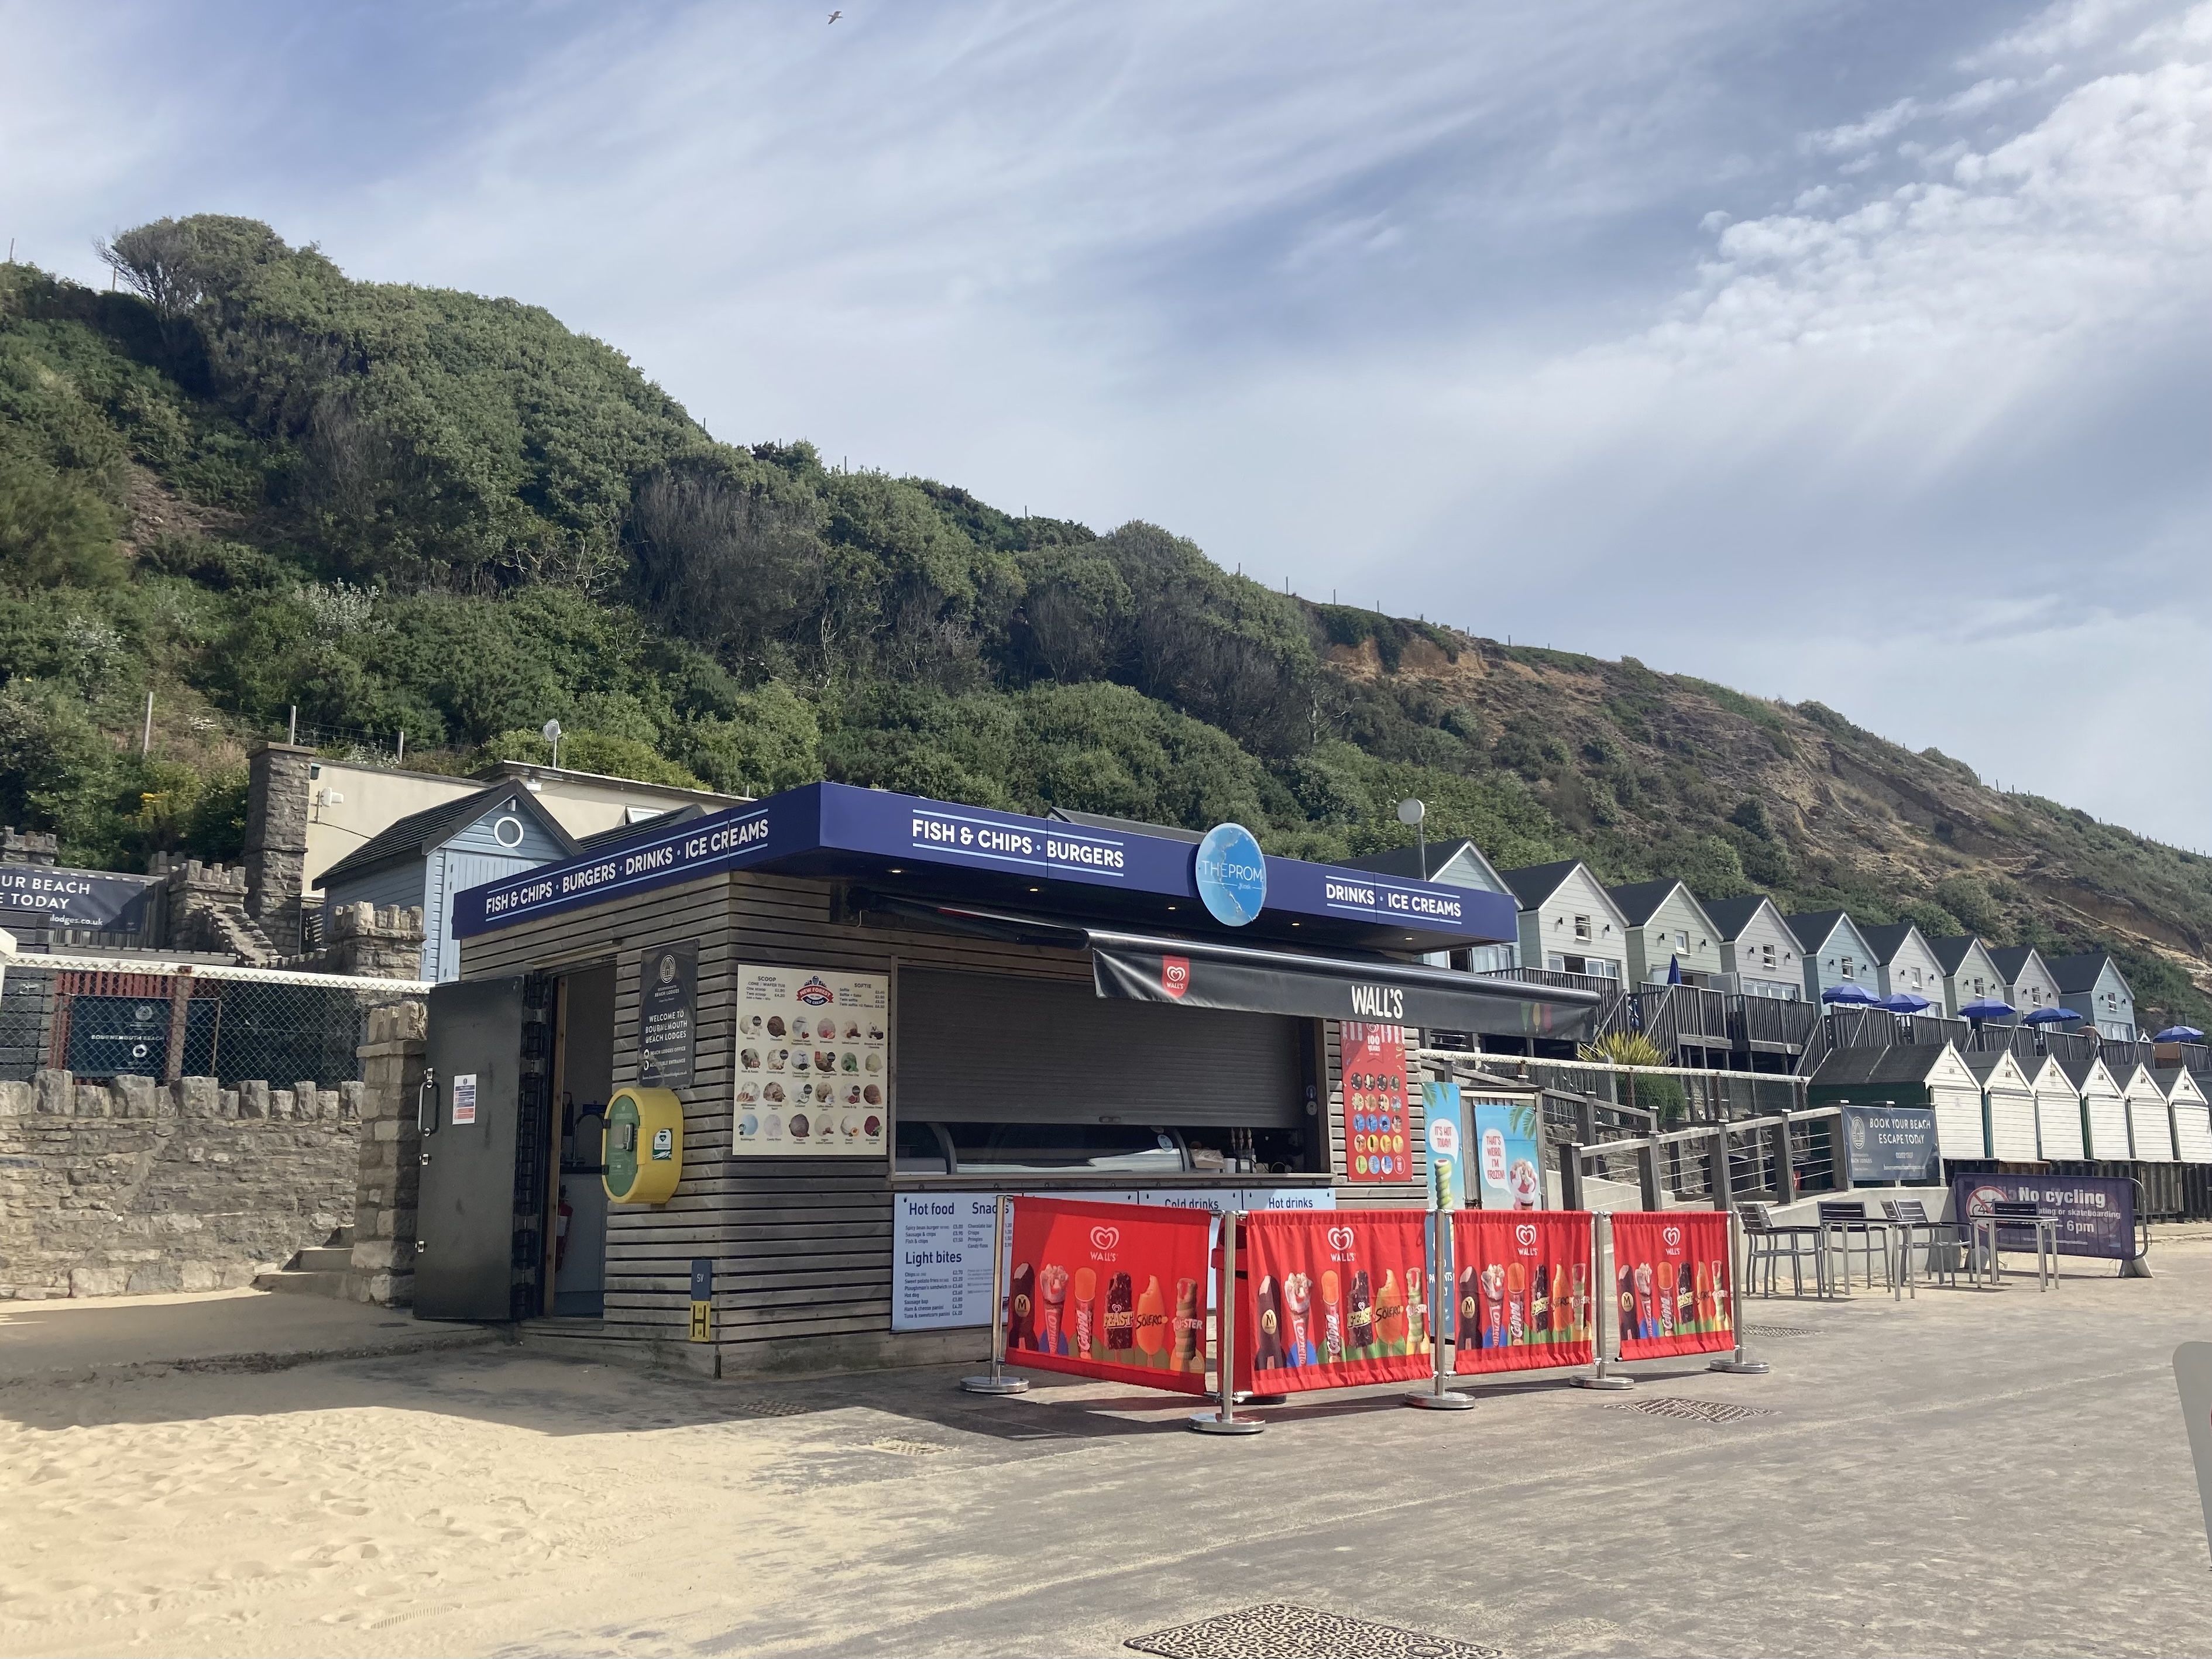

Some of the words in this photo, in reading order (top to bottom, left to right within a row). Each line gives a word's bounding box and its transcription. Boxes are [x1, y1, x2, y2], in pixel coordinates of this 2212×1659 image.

[912, 819, 955, 843] FISH
[960, 827, 974, 845] &
[977, 830, 1032, 854] CHIPS
[1047, 841, 1124, 868] BURGERS
[486, 893, 509, 914] FISH
[510, 891, 518, 907] &
[520, 881, 552, 904] CHIPS
[562, 863, 616, 893] BURGERS
[626, 847, 673, 875] DRINKS
[685, 837, 707, 858] ICE
[710, 819, 768, 851] CREAMS
[1, 875, 26, 888] UR
[32, 878, 90, 895] BEACH
[11, 893, 70, 909] TODAY
[1325, 883, 1375, 905] DRINKS
[1387, 892, 1409, 910] ICE
[1411, 897, 1462, 917] CREAMS
[799, 988, 812, 996] NEW
[812, 987, 831, 997] FOREST
[1351, 985, 1403, 1019] WALL'S
[649, 1012, 675, 1022] WELCOME
[645, 1034, 664, 1044] BEACH
[665, 1031, 686, 1040] LODGES
[1367, 1035, 1380, 1045] 100
[1870, 1118, 1890, 1129] BOOK
[1891, 1119, 1908, 1129] YOUR
[1910, 1119, 1931, 1129] BEACH
[1434, 1126, 1443, 1136] IT'S
[1444, 1126, 1452, 1136] HOT
[1437, 1138, 1451, 1148] TODAY!
[1486, 1136, 1501, 1146] THAT'S
[1878, 1134, 1904, 1144] ESCAPE
[1905, 1134, 1925, 1145] TODAY
[1487, 1148, 1502, 1157] WEIRD,
[1488, 1170, 1505, 1180] FROZEN!
[1269, 1197, 1283, 1208] Hot
[1286, 1197, 1313, 1208] drinks
[2019, 1187, 2039, 1201] No
[2045, 1189, 2105, 1208] cycling
[909, 1203, 928, 1215] Hot
[932, 1203, 954, 1215] food
[972, 1202, 1009, 1214] Snacs
[1165, 1198, 1186, 1208] Cold
[1189, 1198, 1218, 1210] drinks
[2067, 1209, 2121, 1220] skateboarding
[2066, 1220, 2094, 1234] 6pm
[1090, 1251, 1116, 1262] WALL'S
[1331, 1252, 1355, 1262] WALL'S
[1518, 1248, 1537, 1256] WALL'S
[906, 1252, 933, 1267] Light
[936, 1251, 962, 1263] bites
[696, 1273, 704, 1283] SV
[1104, 1311, 1134, 1328] FEAST
[1375, 1305, 1400, 1323] SOLERO
[1136, 1314, 1162, 1329] SOLERO
